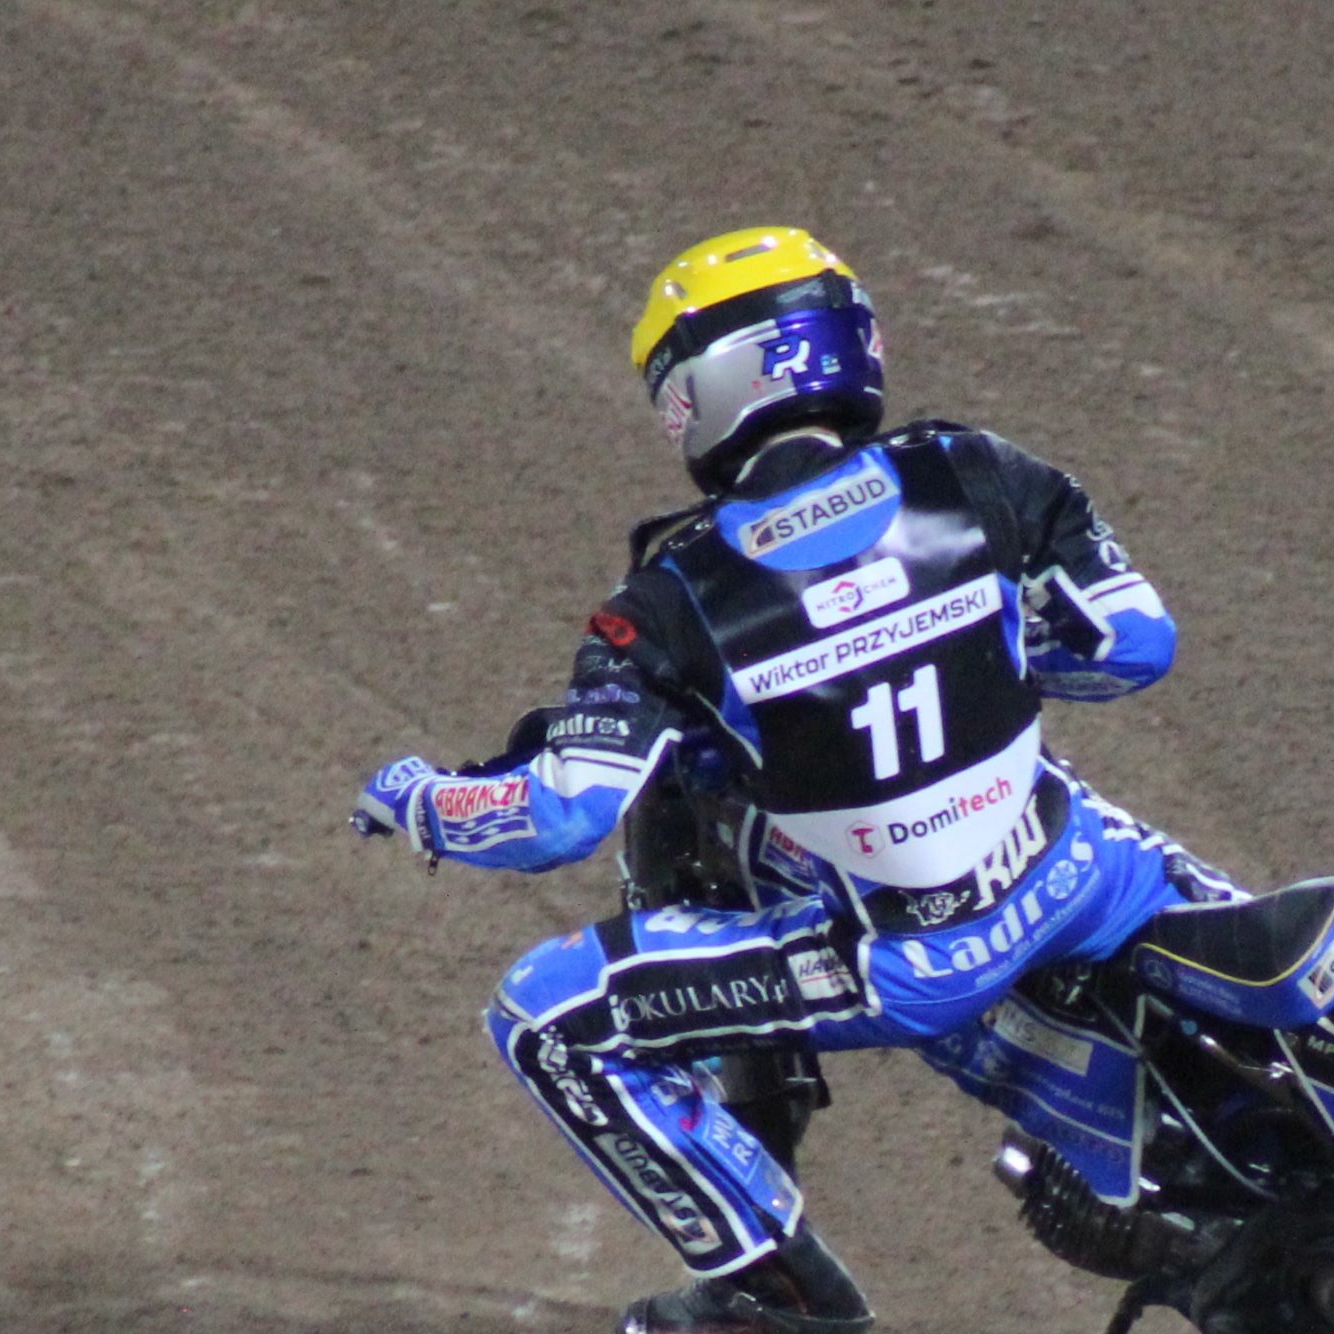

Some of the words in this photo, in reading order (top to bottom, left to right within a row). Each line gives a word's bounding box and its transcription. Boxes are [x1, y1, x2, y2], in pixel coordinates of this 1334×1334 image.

[775, 477, 886, 540] STABUD
[749, 652, 829, 695] Wiktor
[835, 588, 987, 663] PRZYJEMSKI
[850, 663, 945, 780] 11
[888, 777, 1013, 845] Domitech
